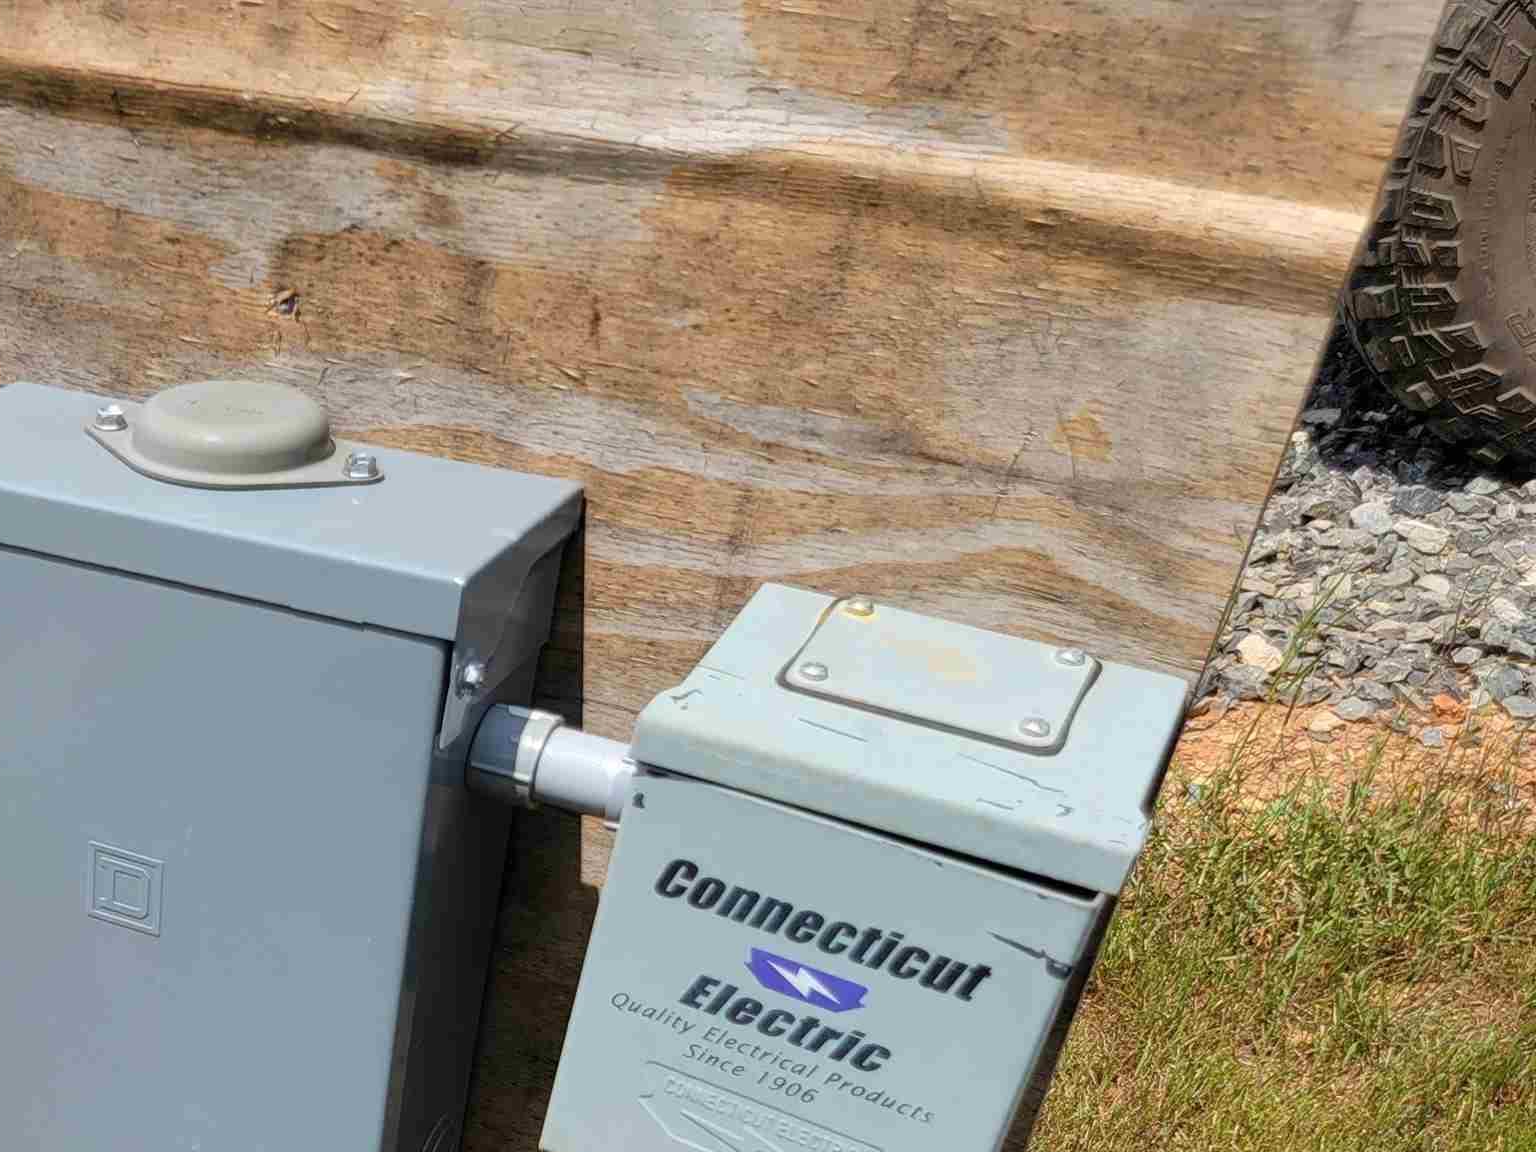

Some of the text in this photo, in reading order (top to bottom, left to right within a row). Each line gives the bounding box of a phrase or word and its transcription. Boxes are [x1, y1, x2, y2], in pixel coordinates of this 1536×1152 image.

[653, 858, 993, 1002] Connecticut
[610, 992, 937, 1125] Quality Electrical Products
[678, 974, 893, 1072] Electric
[683, 1043, 817, 1105] Since 1906
